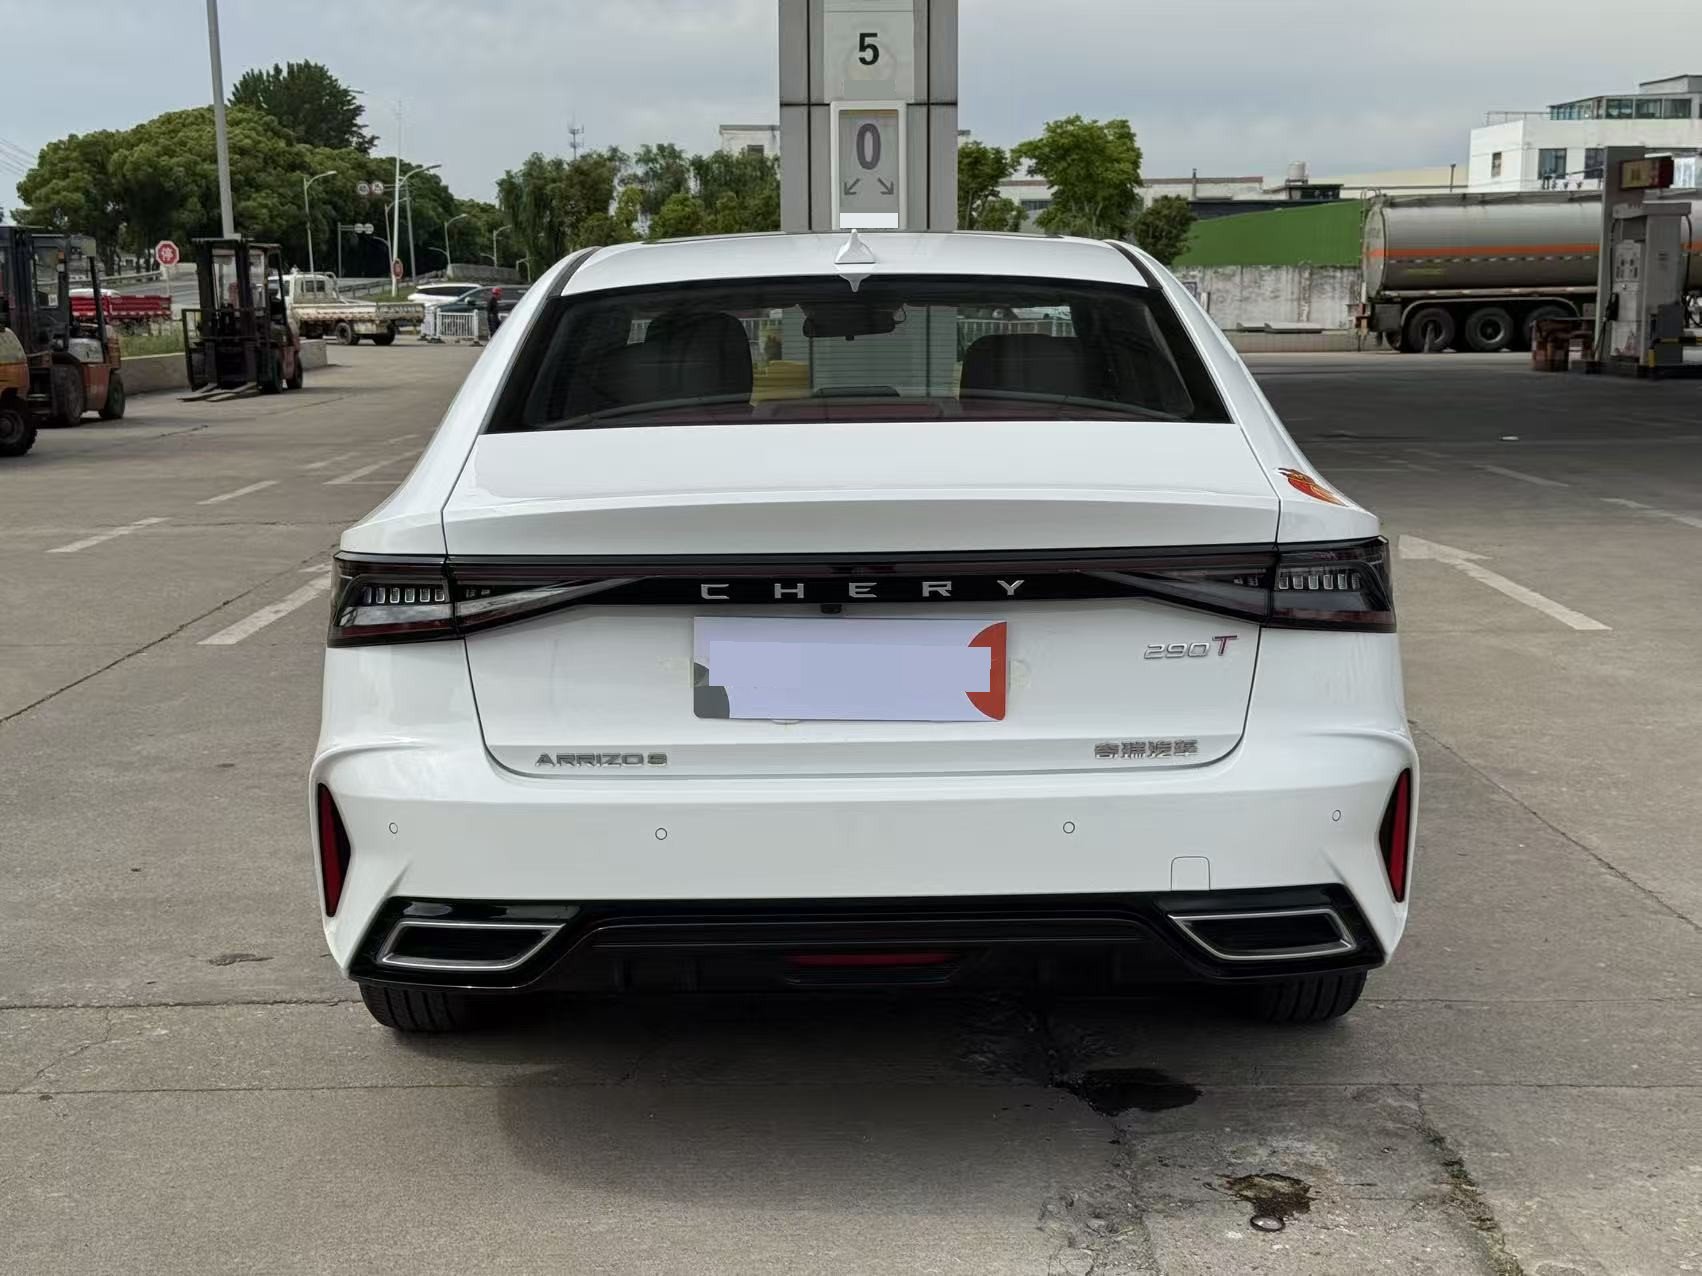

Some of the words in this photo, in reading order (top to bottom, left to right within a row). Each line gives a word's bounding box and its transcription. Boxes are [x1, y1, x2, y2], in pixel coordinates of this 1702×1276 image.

[858, 32, 880, 66] 5
[856, 123, 882, 171] 0
[700, 579, 1025, 600] CHERY
[1144, 634, 1238, 659] 290T
[1093, 739, 1199, 760] 奇瑞汽车
